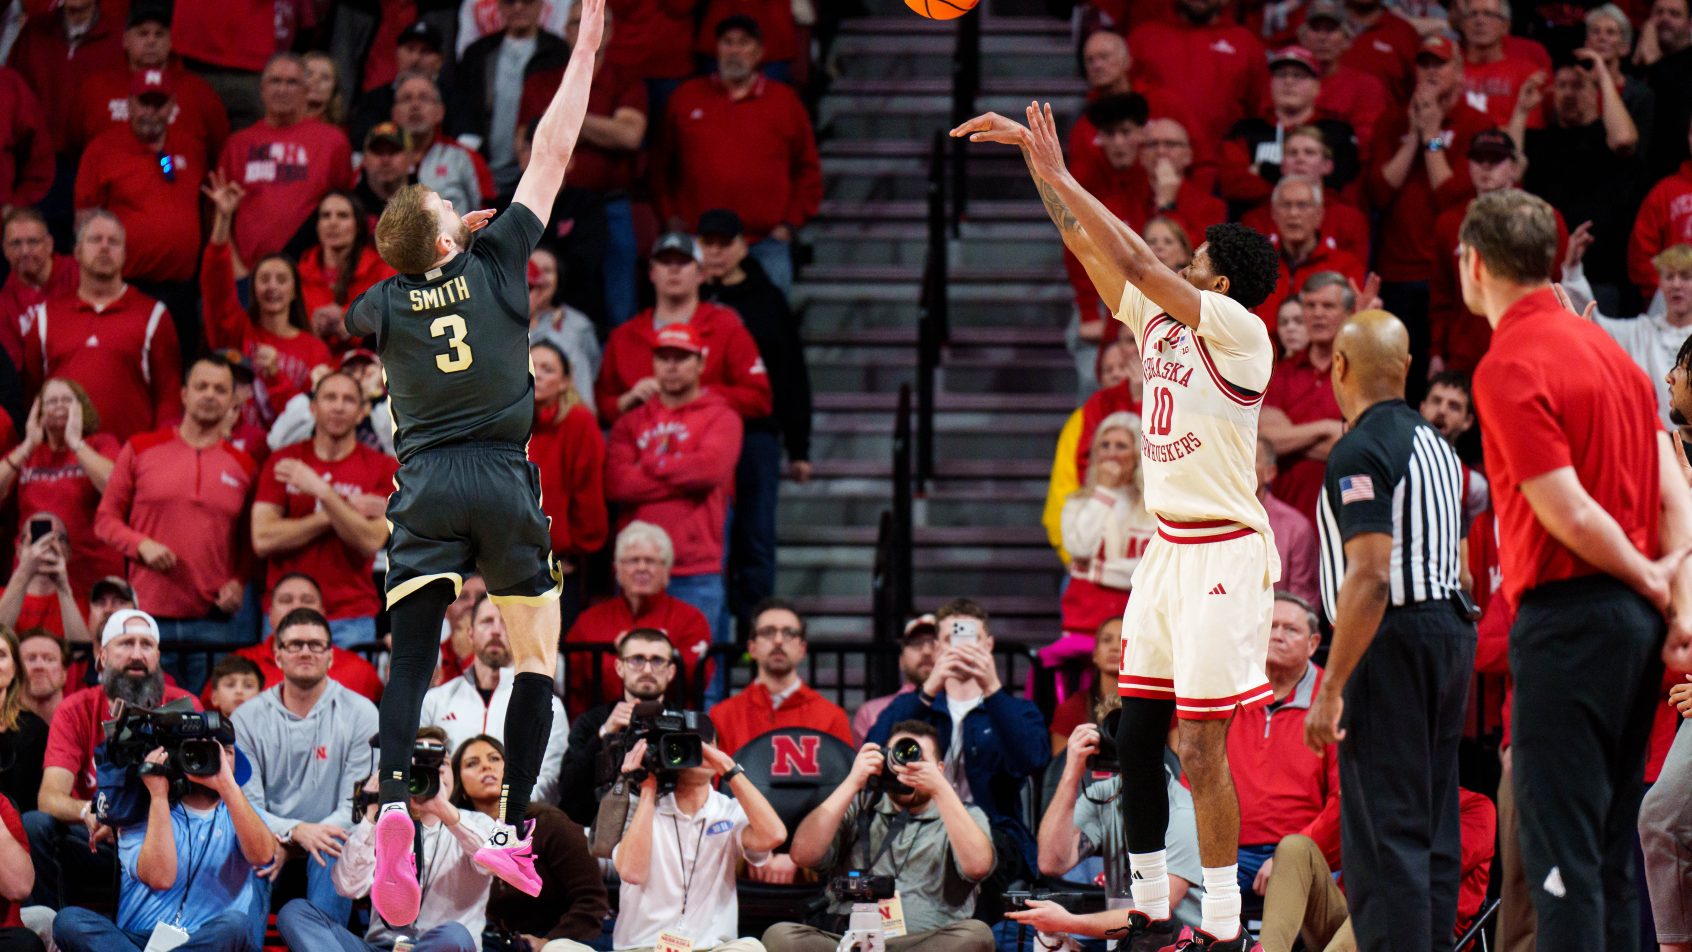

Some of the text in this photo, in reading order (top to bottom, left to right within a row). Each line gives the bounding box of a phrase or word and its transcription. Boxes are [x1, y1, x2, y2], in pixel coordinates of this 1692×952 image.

[409, 275, 470, 312] SMITH
[429, 313, 473, 374] 3
[1149, 386, 1174, 436] 10
[771, 735, 821, 777] N
